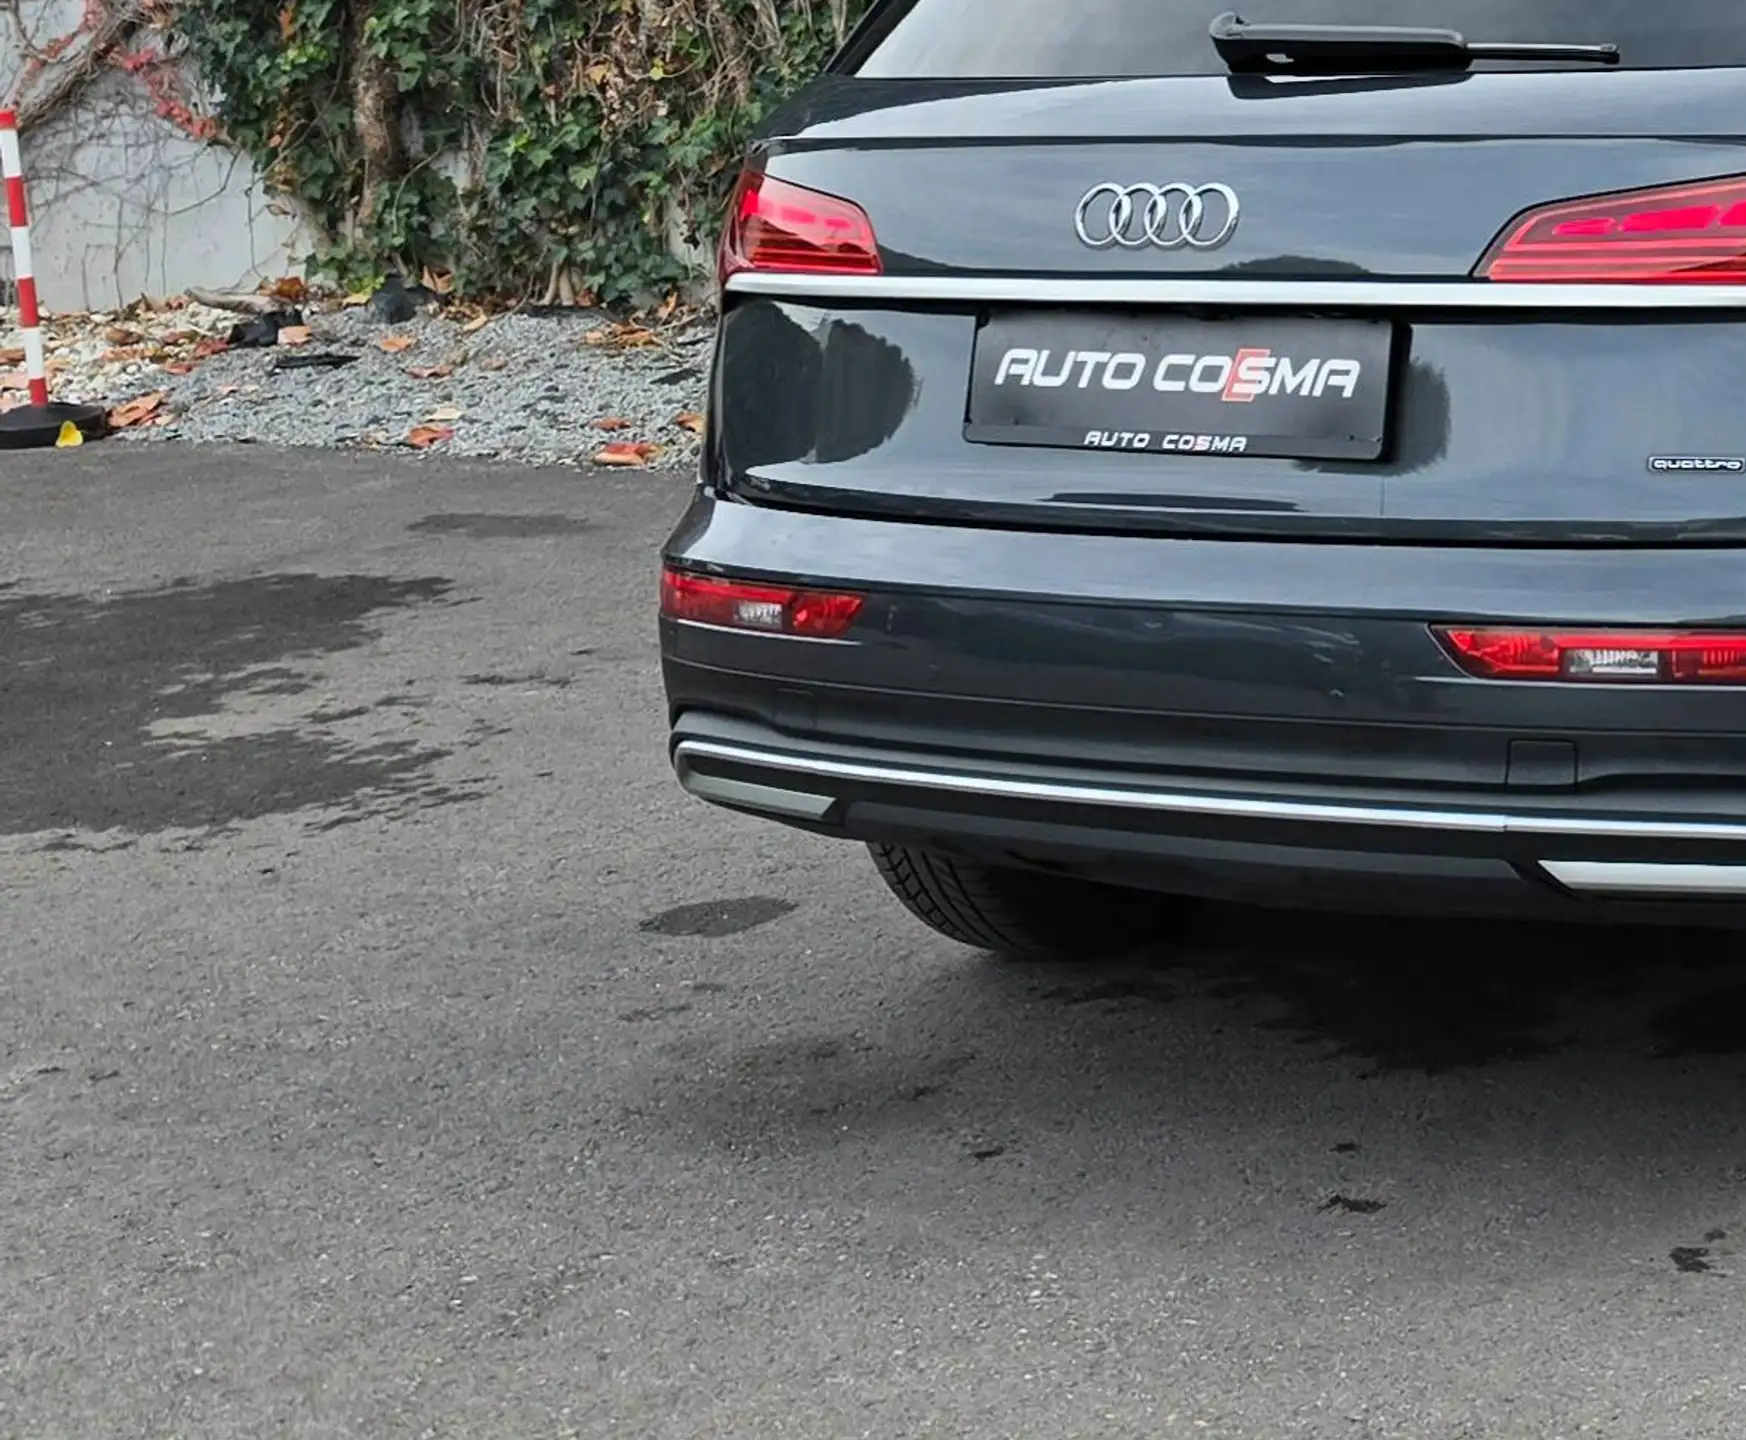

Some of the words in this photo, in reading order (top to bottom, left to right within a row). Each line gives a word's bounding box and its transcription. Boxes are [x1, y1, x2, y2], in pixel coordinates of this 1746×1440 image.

[995, 348, 1147, 391] AUTO
[1152, 350, 1360, 400] COSMA
[1084, 430, 1149, 448] AUTO
[1162, 434, 1248, 453] COSMA
[1653, 458, 1742, 470] quattro
